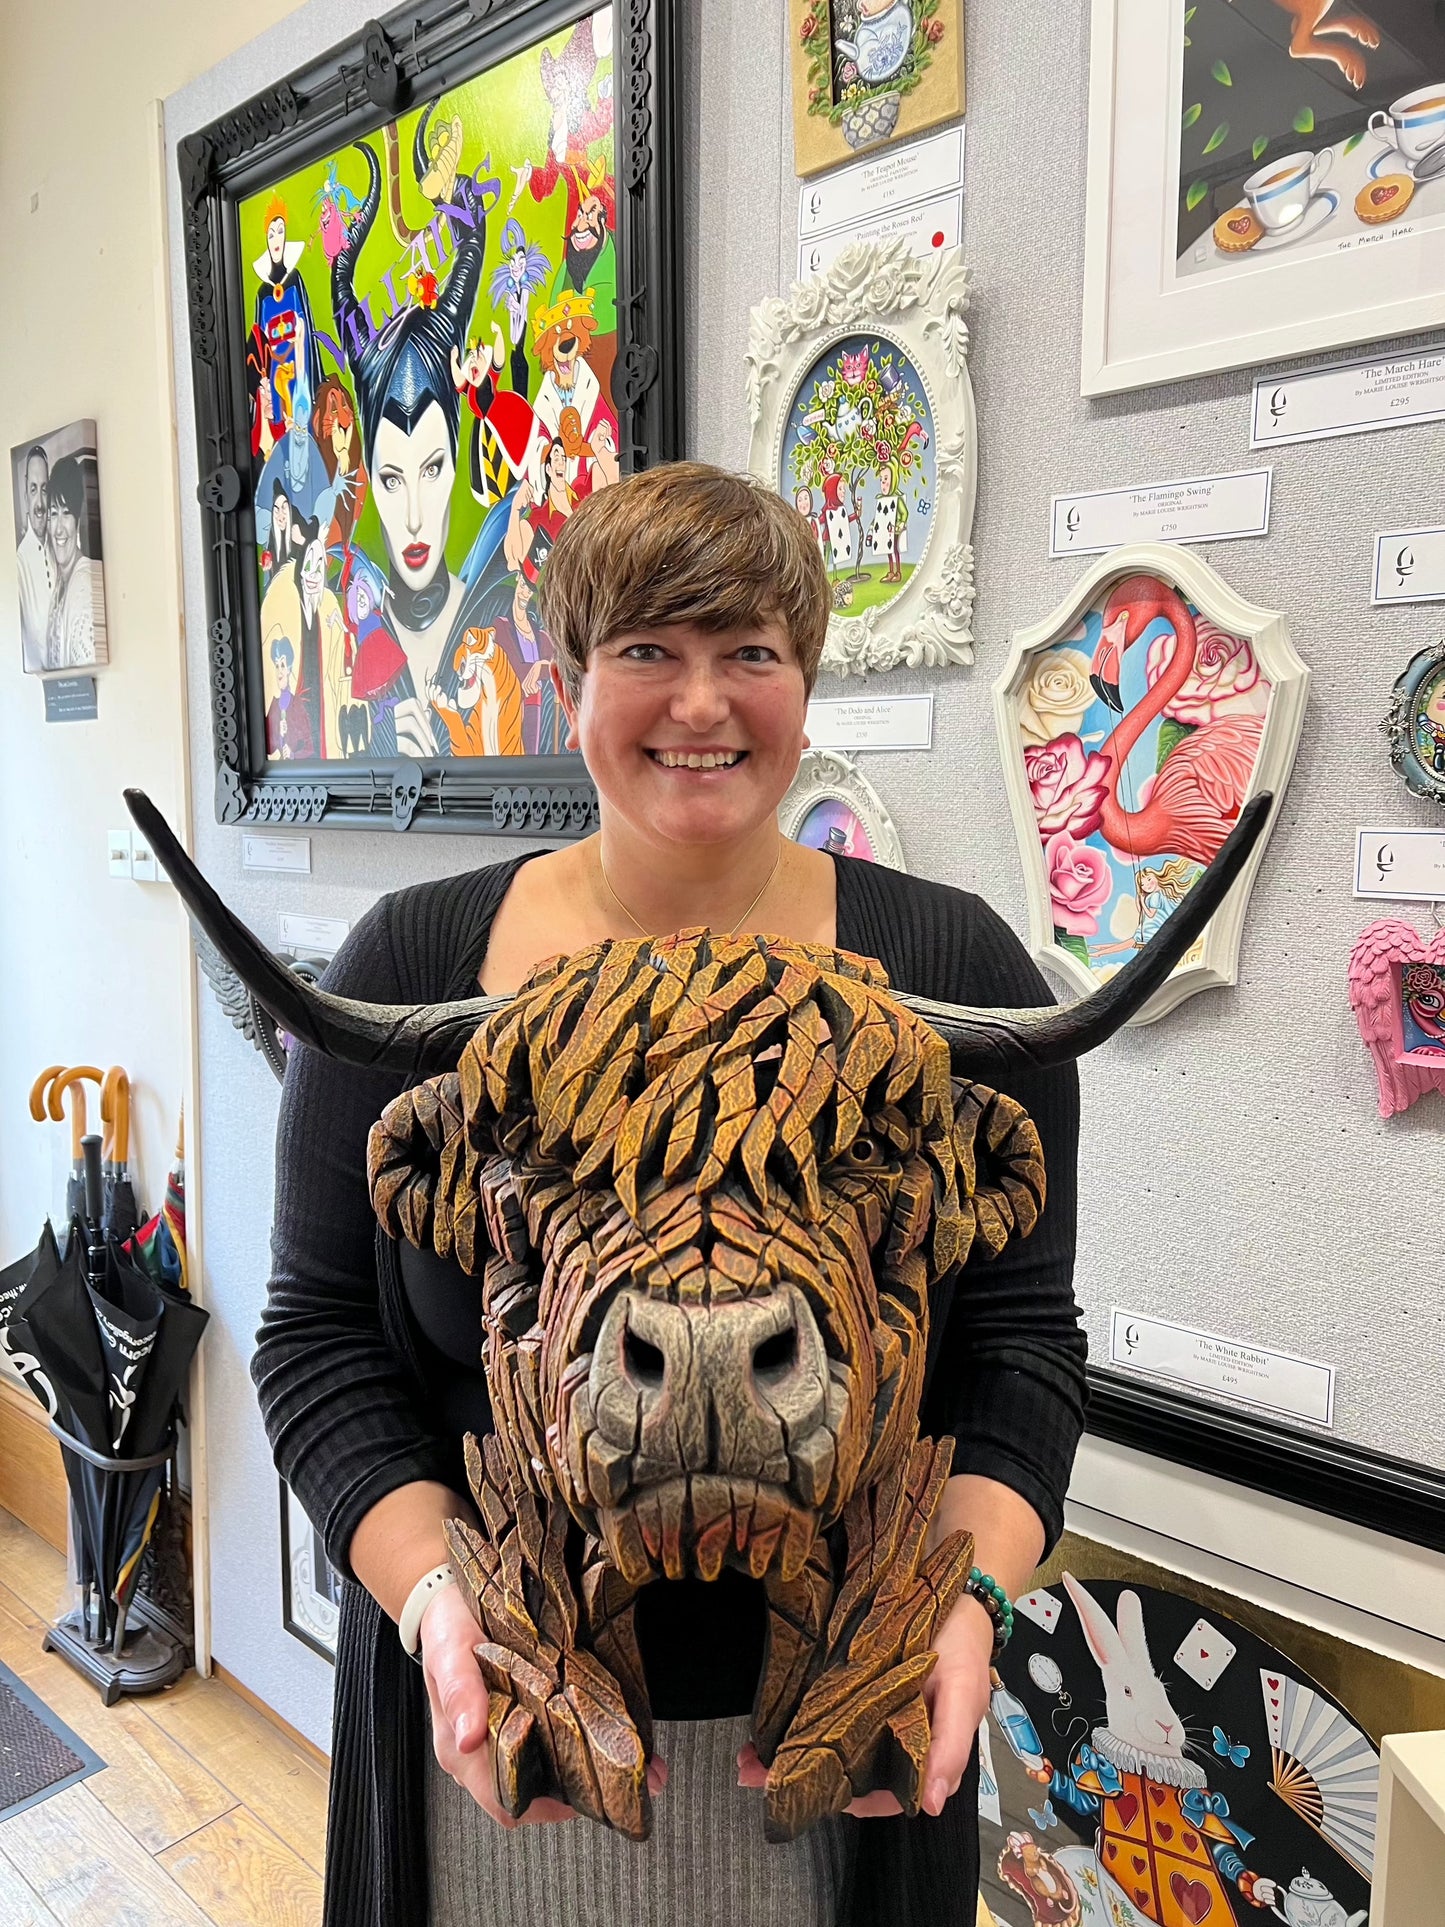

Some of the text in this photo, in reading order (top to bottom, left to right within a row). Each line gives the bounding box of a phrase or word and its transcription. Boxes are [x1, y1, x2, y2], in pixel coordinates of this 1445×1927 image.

[876, 162, 895, 174] Teapot
[881, 225, 890, 233] the
[892, 220, 910, 230] Roses
[313, 152, 500, 374] VILLAINS
[1385, 362, 1415, 376] March
[1375, 371, 1429, 385] LIMITED EDITION
[1364, 386, 1384, 394] MARIE
[1385, 382, 1408, 391] LOUISE
[1390, 397, 1410, 407] £295
[1148, 491, 1185, 501] Flamingo
[1176, 503, 1209, 511] WRIGHTSON
[1161, 523, 1178, 532] £750
[864, 706, 874, 714] and
[1215, 1344, 1238, 1358] White
[1209, 1352, 1254, 1369] LIMITED EDITION
[1200, 1355, 1217, 1365] MARIE
[1217, 1360, 1236, 1370] LOUISE
[1237, 1366, 1270, 1379] WRIGHTSON
[1222, 1374, 1238, 1385] £495
